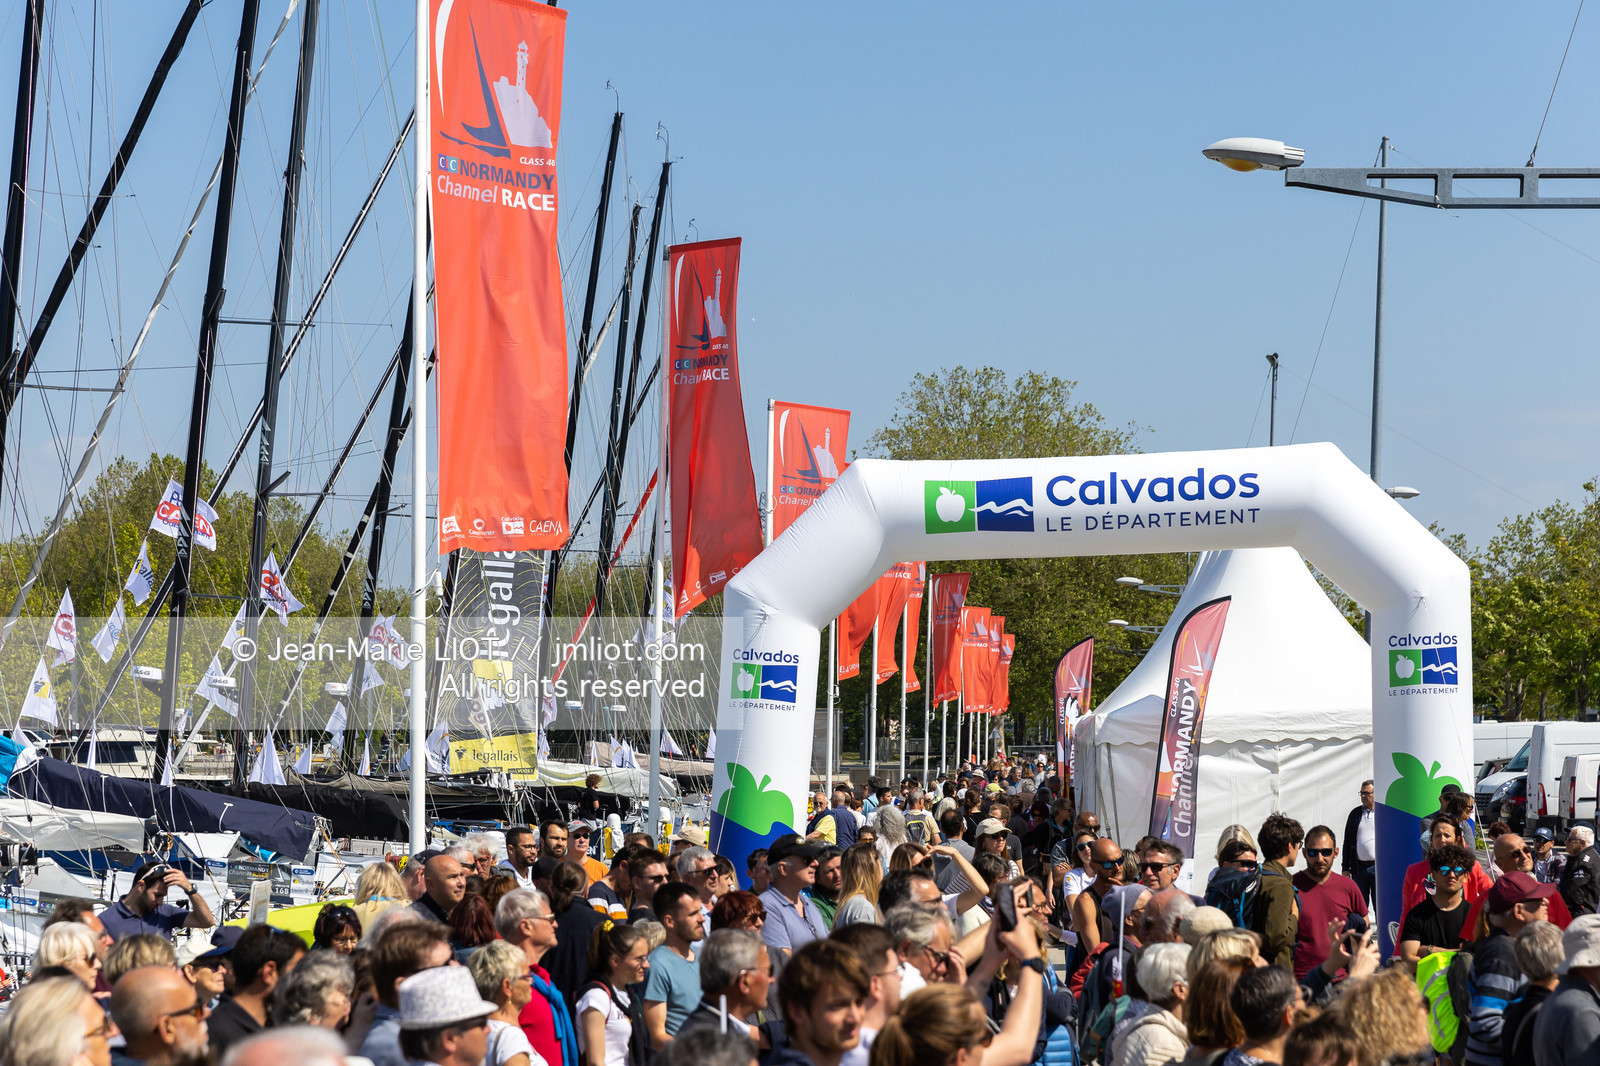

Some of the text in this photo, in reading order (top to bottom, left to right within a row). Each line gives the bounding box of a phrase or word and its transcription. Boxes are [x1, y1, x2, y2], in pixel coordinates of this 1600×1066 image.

[520, 156, 555, 167] CLASS 40
[460, 159, 554, 190] NORMANDY
[437, 175, 555, 211] Channel RACE
[1046, 467, 1261, 507] Calvados
[1046, 507, 1261, 532] LE DÉPARTEMENT
[1388, 632, 1458, 647] Calvados
[732, 648, 800, 664] Calvados
[1170, 677, 1181, 718] CLASS 40
[1400, 687, 1459, 696] DÉPARTEMENT
[739, 701, 797, 711] DÉPARTEMENT
[472, 749, 519, 764] legallais
[238, 863, 270, 872] NORMANDY
